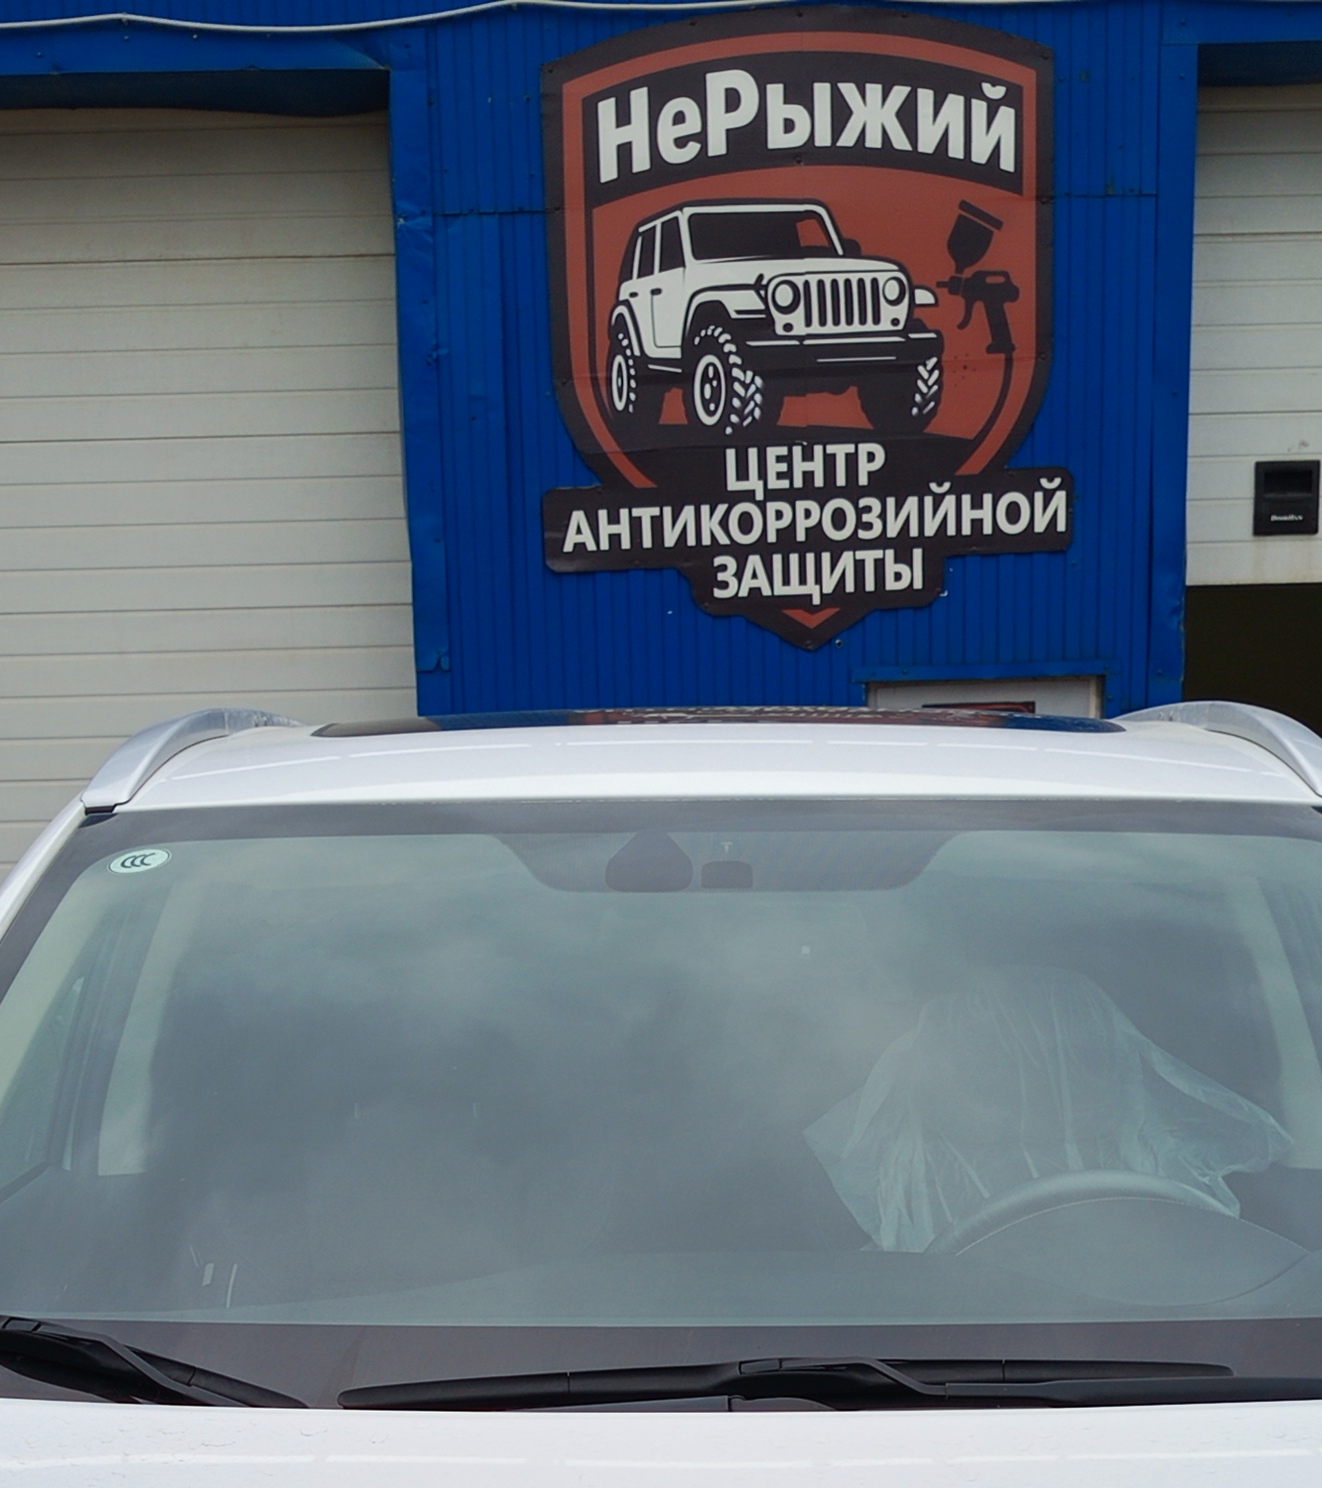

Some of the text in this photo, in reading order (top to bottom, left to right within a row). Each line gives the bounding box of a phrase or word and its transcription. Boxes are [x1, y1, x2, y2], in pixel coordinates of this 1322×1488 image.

[596, 68, 1017, 184] НеРыжий
[725, 442, 886, 501] ЦЕНТР
[563, 477, 1068, 553] АНТИКОРРОЗИЙНОЙ
[712, 548, 923, 605] ЗАЩИТЫ
